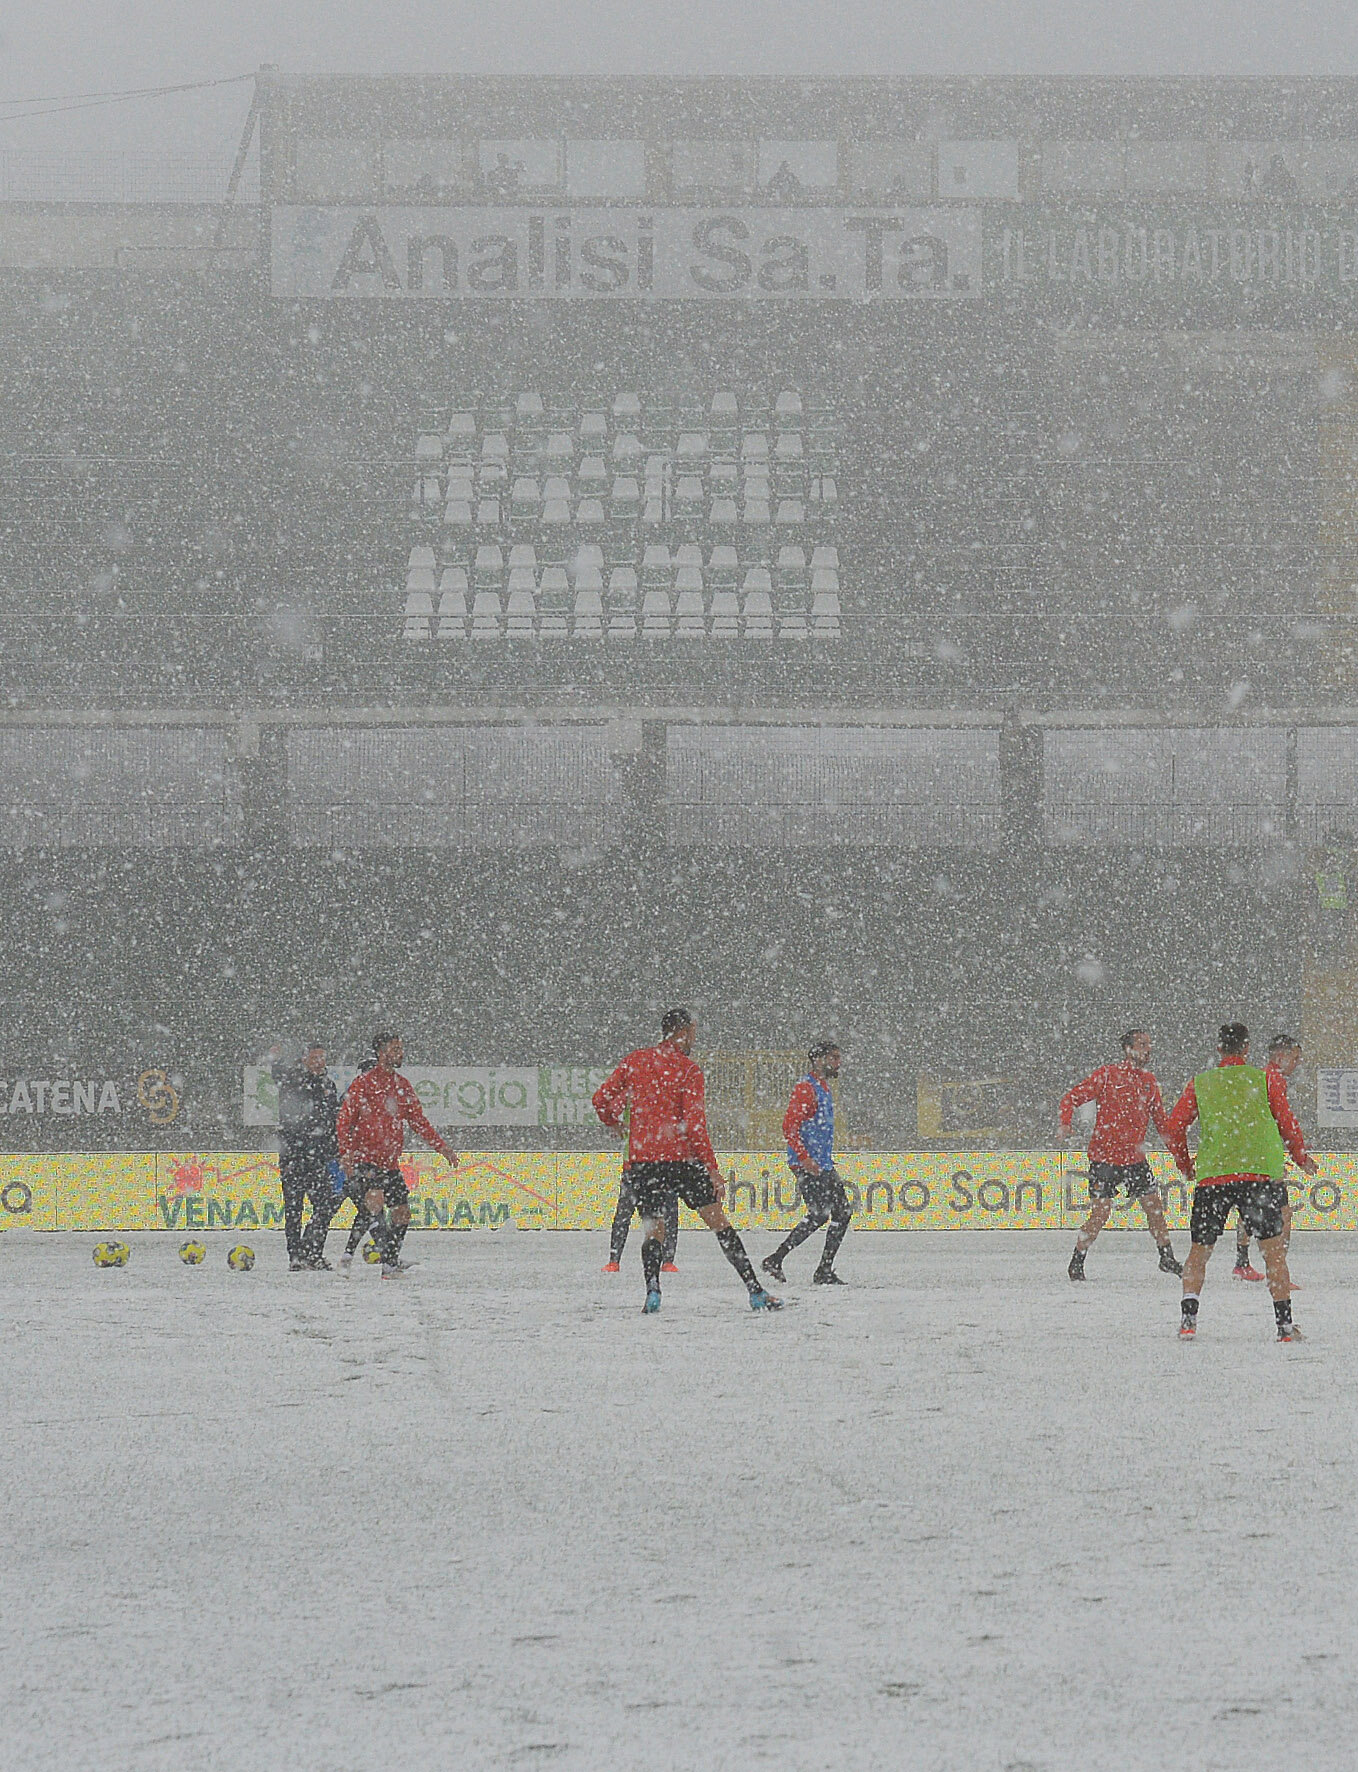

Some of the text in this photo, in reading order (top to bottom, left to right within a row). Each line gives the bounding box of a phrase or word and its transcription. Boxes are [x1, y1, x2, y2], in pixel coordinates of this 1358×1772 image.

[331, 215, 970, 292] Analisi Sa.Ta.
[995, 227, 1036, 282] IL
[1044, 225, 1321, 283] LABORATORIO
[949, 1169, 1043, 1213] San
